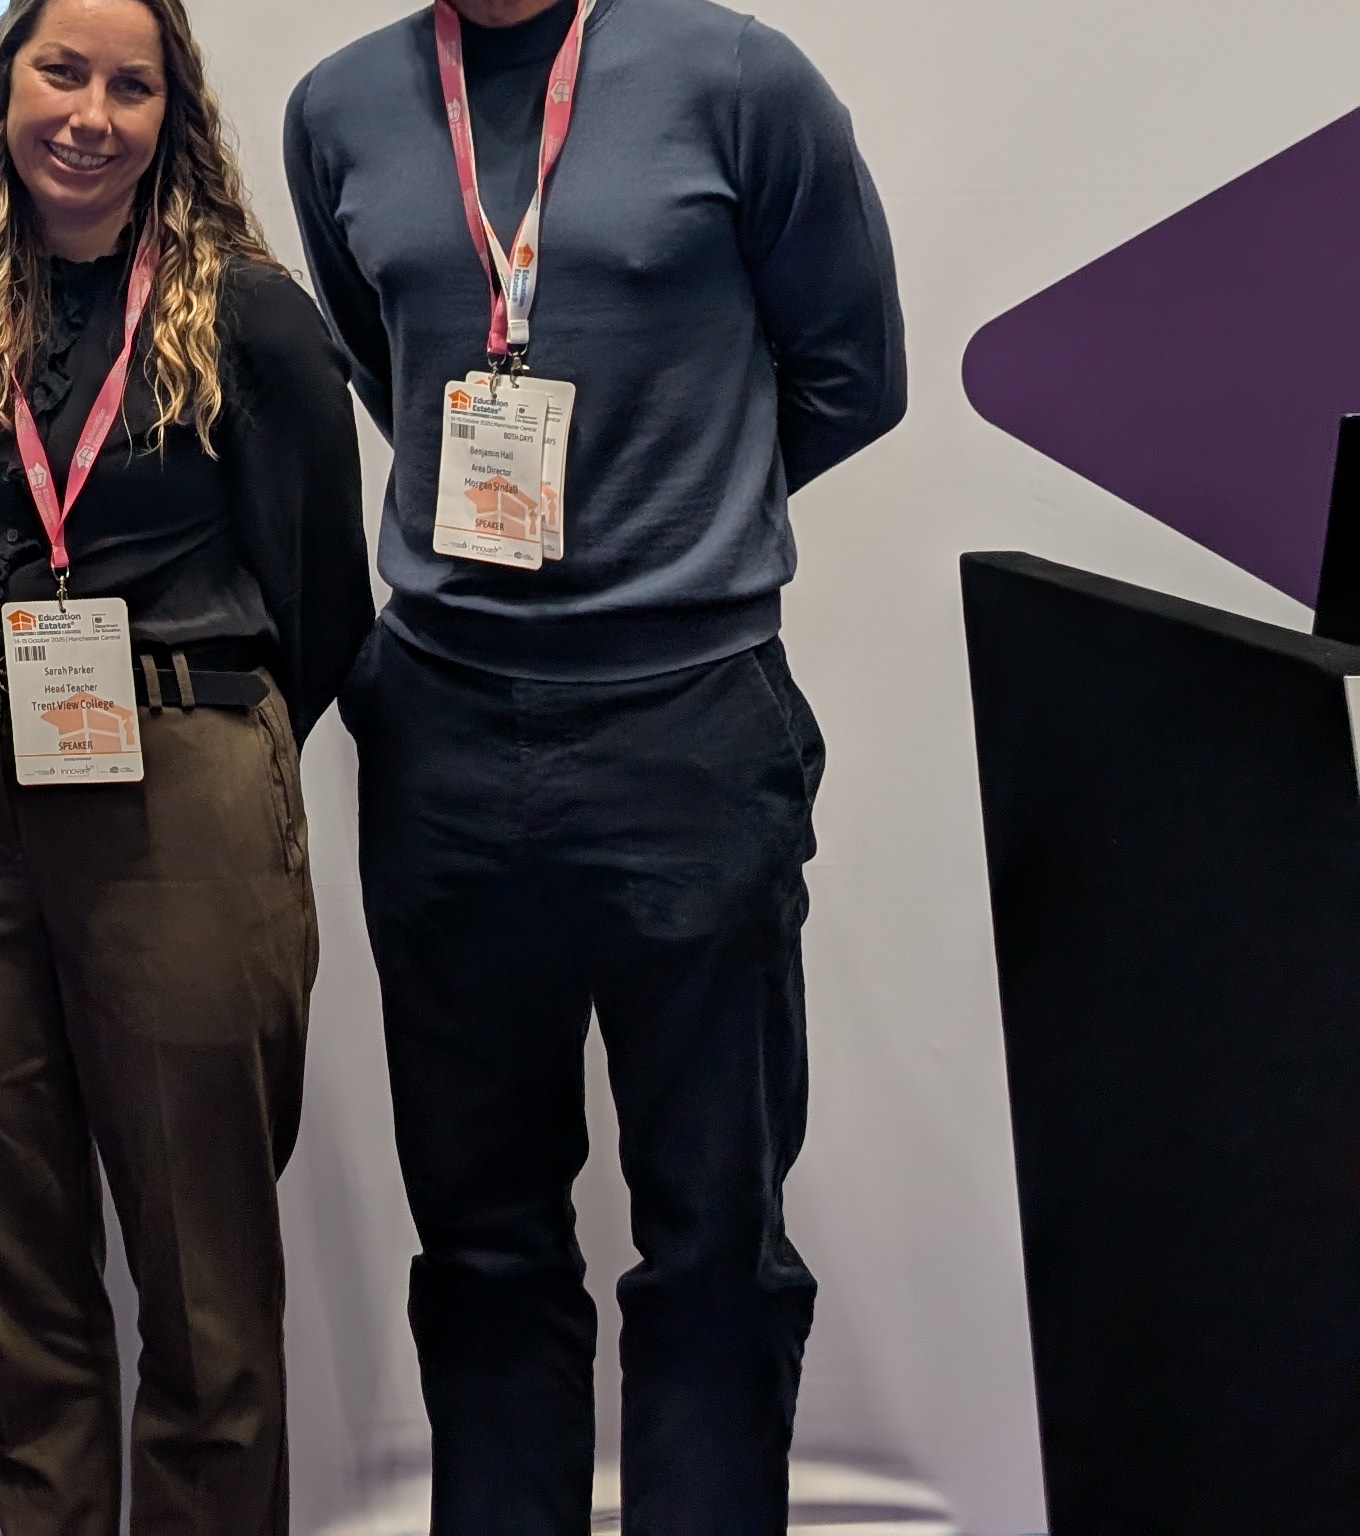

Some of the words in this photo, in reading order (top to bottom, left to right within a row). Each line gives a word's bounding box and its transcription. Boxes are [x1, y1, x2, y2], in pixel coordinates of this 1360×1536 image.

[471, 464, 486, 473] Area
[486, 465, 512, 476] Director
[464, 477, 492, 491] Morgan
[475, 518, 505, 531] SPEAKER
[38, 613, 81, 622] Education
[44, 666, 67, 676] Sarah
[68, 665, 95, 675] Parker
[45, 684, 65, 694] Head
[66, 684, 98, 693] Teacher
[31, 701, 56, 711] Trent
[56, 700, 79, 710] View
[80, 698, 115, 710] College
[58, 741, 93, 751] SPEAKER
